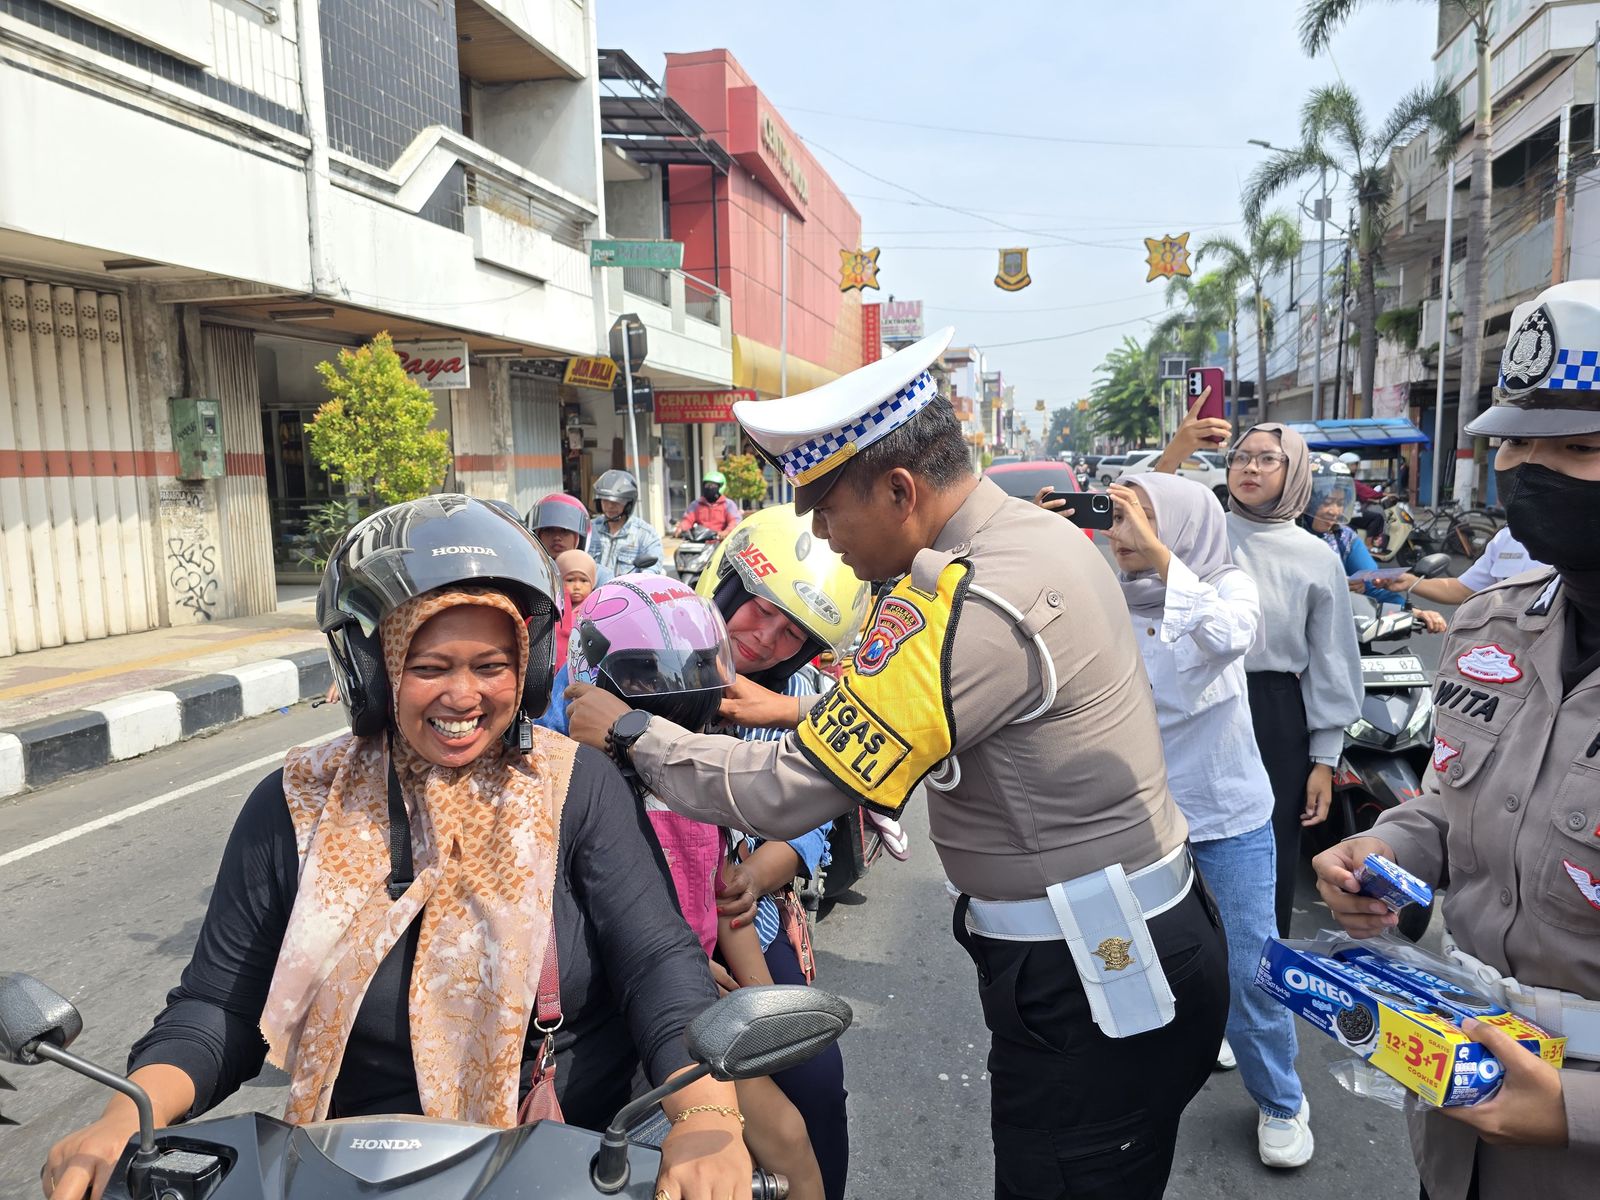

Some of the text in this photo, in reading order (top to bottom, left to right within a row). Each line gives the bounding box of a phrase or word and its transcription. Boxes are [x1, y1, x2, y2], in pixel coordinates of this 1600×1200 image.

[659, 392, 751, 406] CENTRA MODA
[684, 410, 727, 419] TEXTILE
[431, 546, 498, 557] HONDA
[800, 586, 839, 620] INK
[1434, 680, 1500, 722] WITA
[851, 750, 879, 783] LL
[1284, 967, 1354, 1008] OREO
[1388, 963, 1465, 994] OREO
[1404, 1034, 1449, 1082] 3+1
[1428, 1039, 1450, 1054] GRATIS
[1407, 1066, 1439, 1089] COOKIES
[349, 1138, 422, 1150] HONDA
